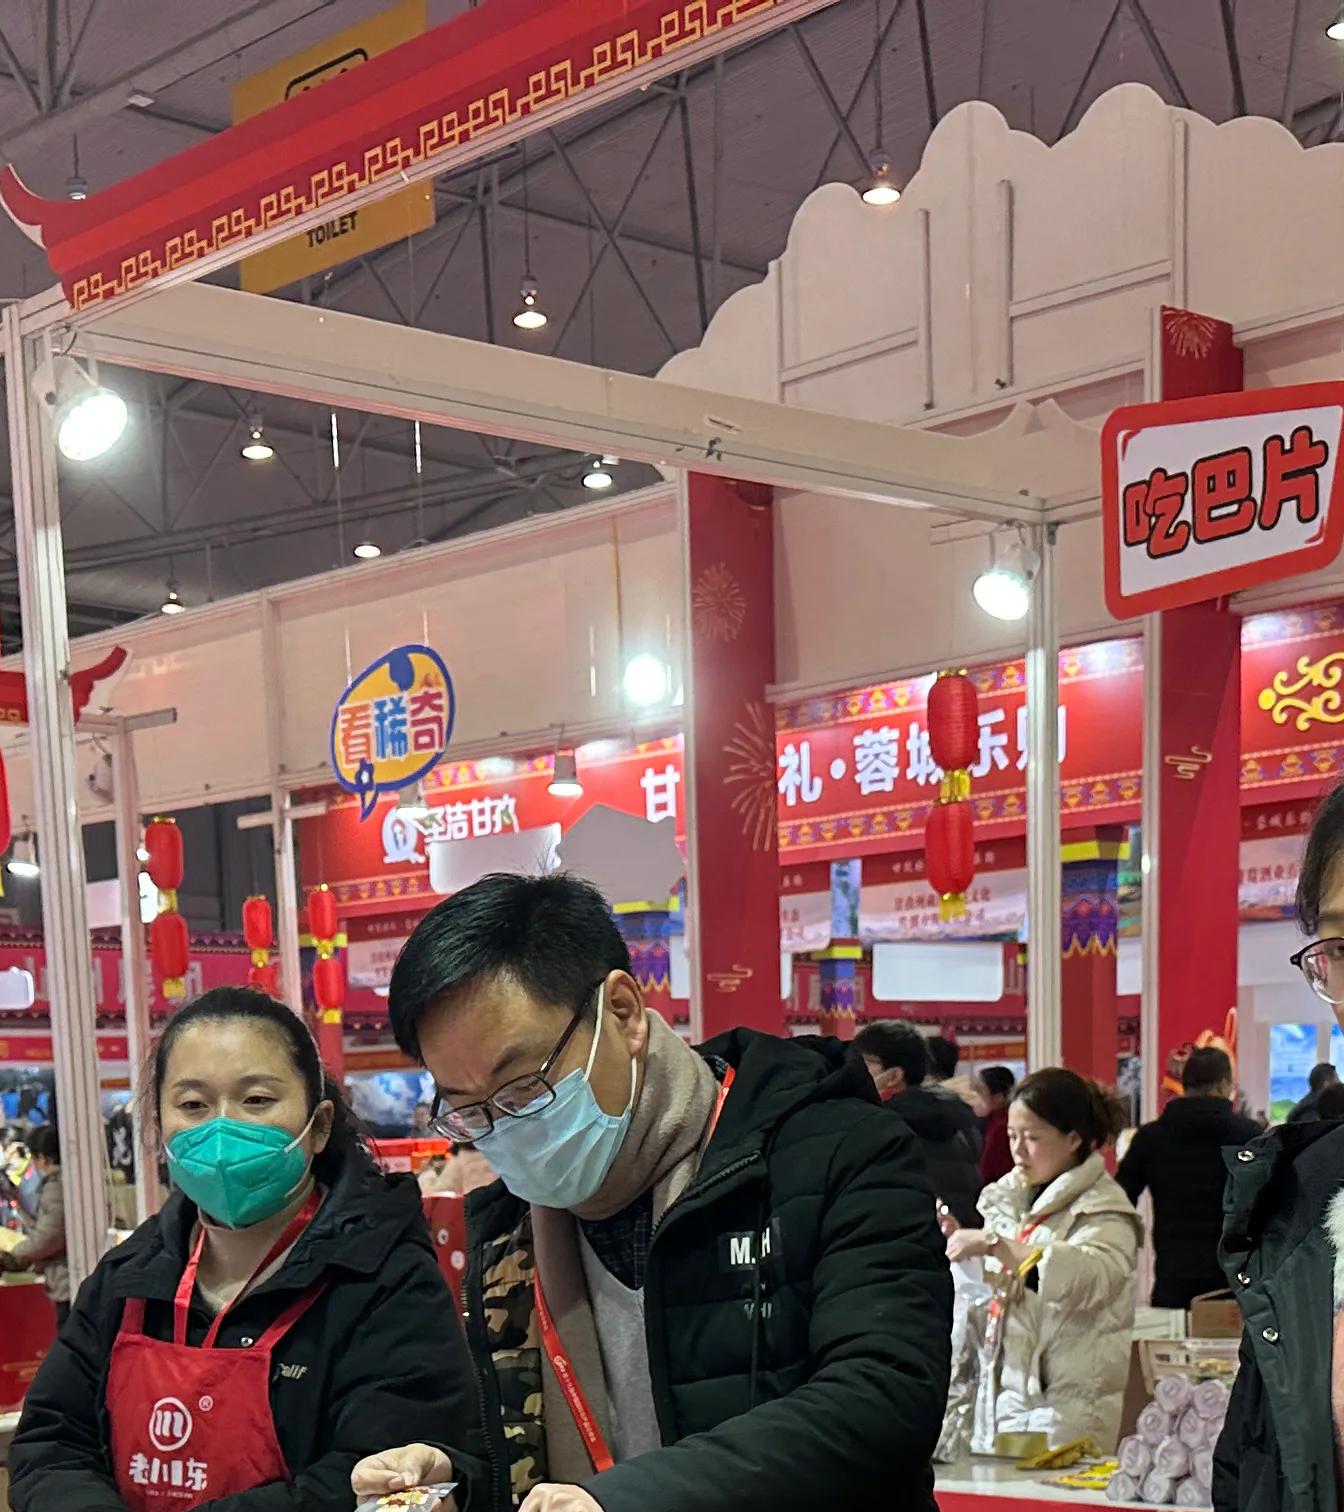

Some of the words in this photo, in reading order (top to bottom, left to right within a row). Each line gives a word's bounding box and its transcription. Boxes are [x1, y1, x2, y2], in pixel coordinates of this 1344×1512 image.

[306, 210, 359, 248] TOILET
[1123, 425, 1330, 559] 吃巴片
[338, 687, 447, 770] 看稀奇
[129, 1452, 208, 1491] 老川东
